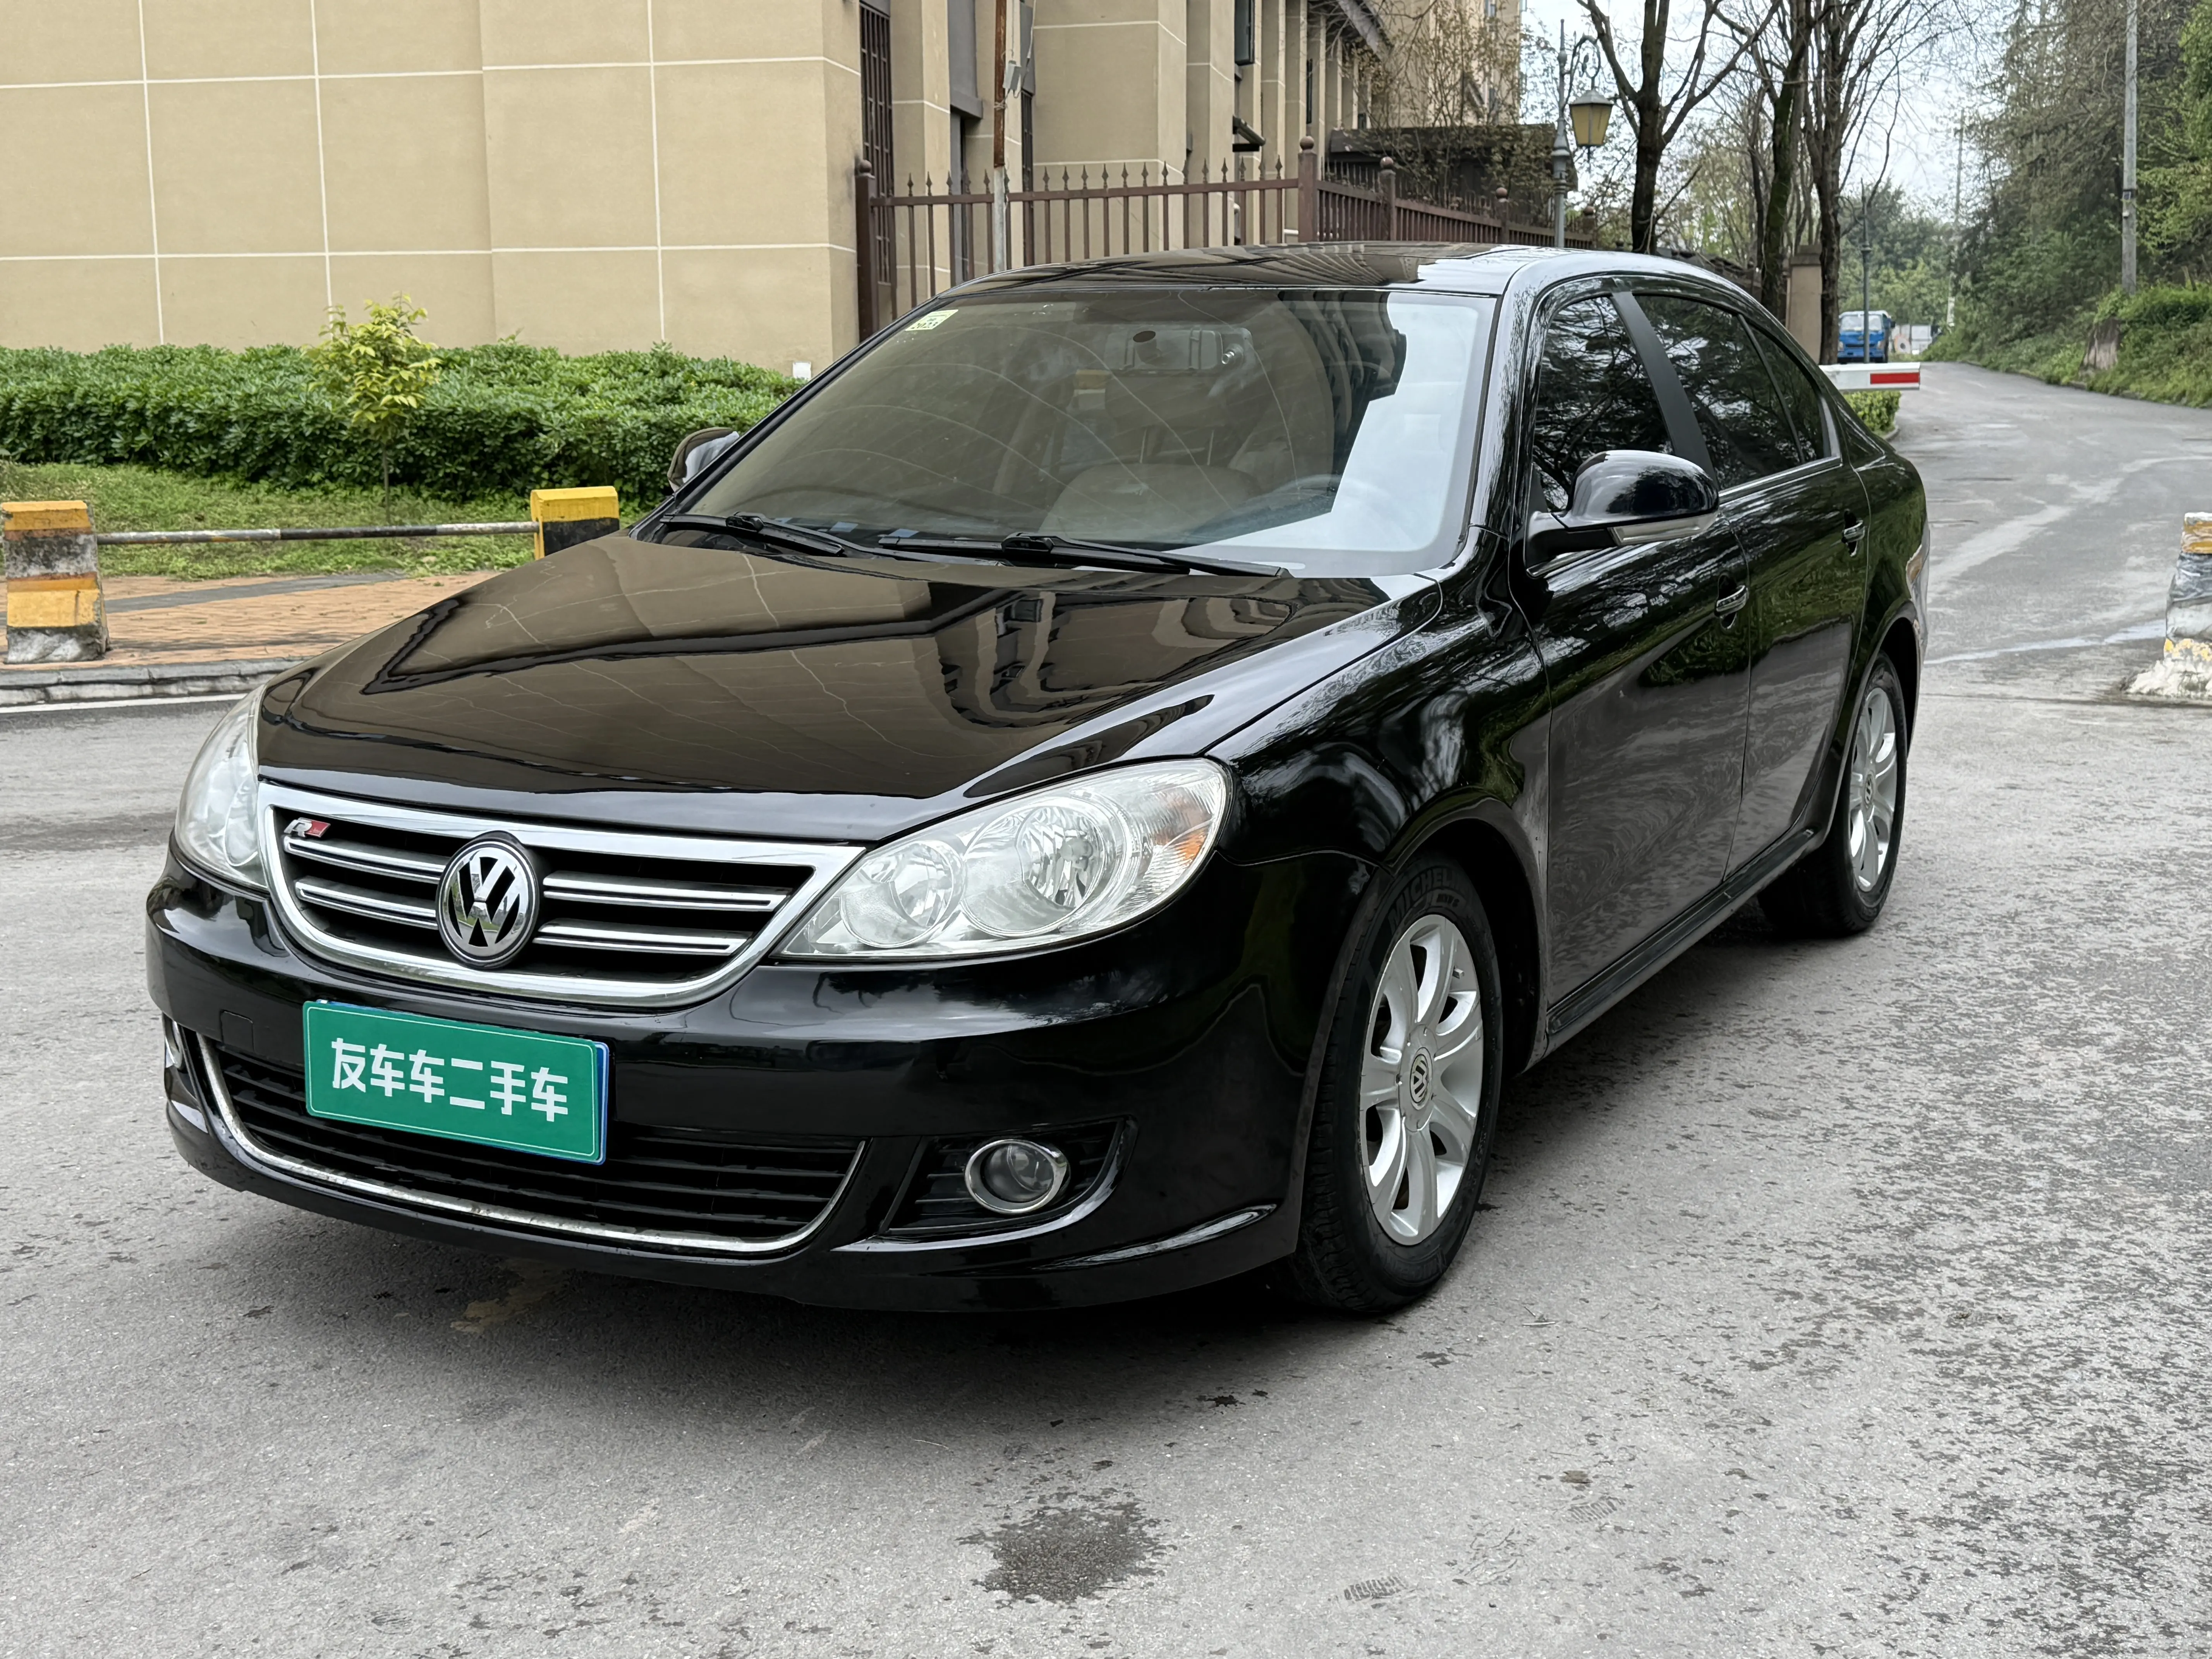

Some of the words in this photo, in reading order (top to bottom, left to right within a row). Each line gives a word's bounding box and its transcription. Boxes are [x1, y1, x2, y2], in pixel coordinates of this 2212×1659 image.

[284, 819, 312, 837] R
[444, 847, 529, 957] VW
[331, 1037, 568, 1122] 友车车二手车
